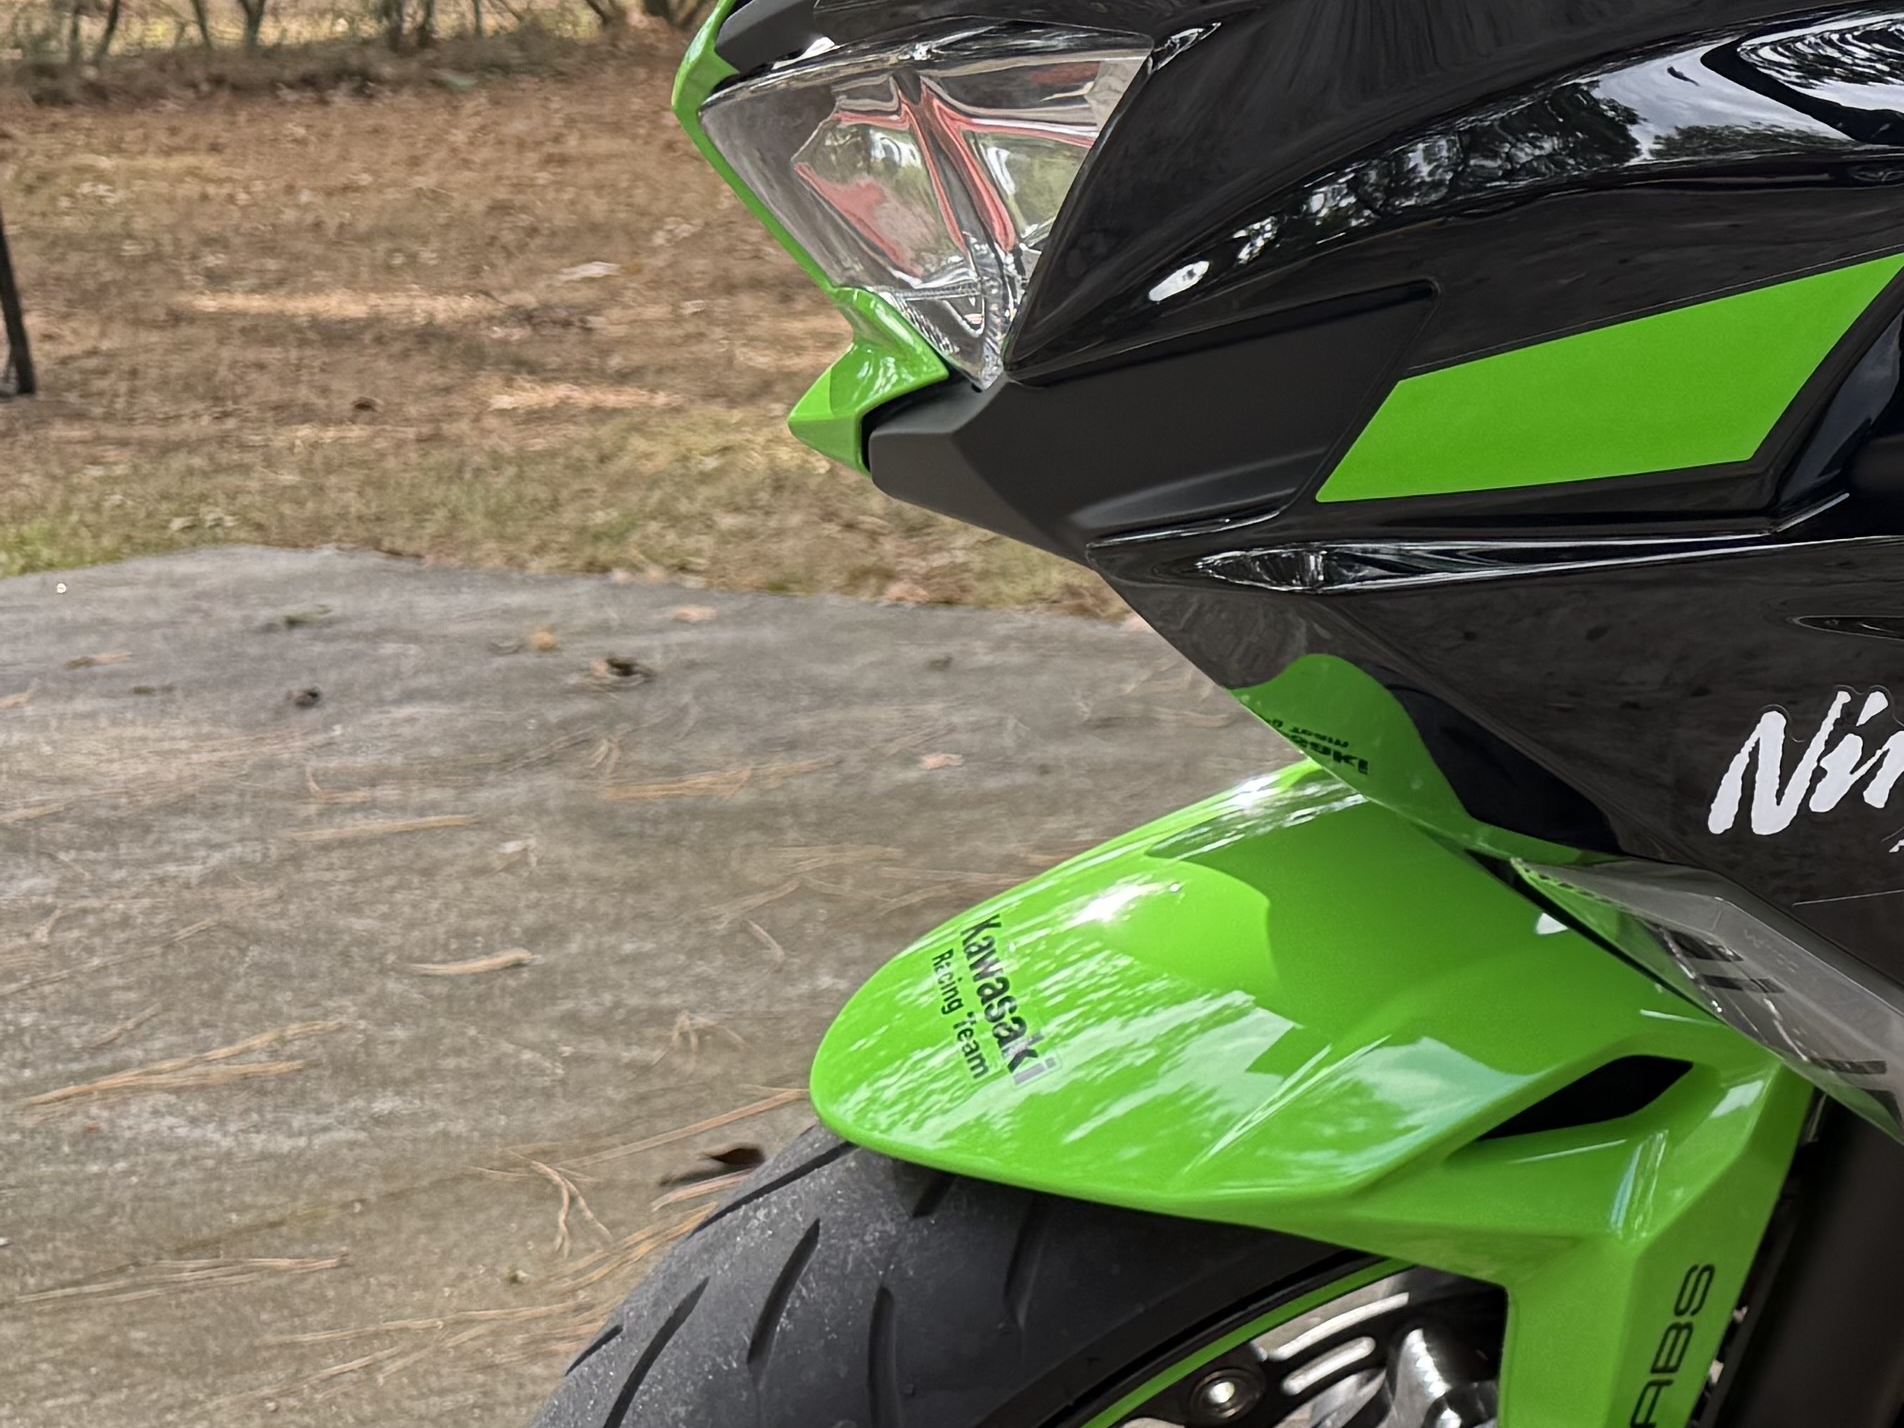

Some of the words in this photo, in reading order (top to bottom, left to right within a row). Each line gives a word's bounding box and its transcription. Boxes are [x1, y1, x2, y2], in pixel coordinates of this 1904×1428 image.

[932, 948, 964, 1015] Racing
[953, 1011, 989, 1079] Team
[960, 913, 1057, 1085] Kawasaki
